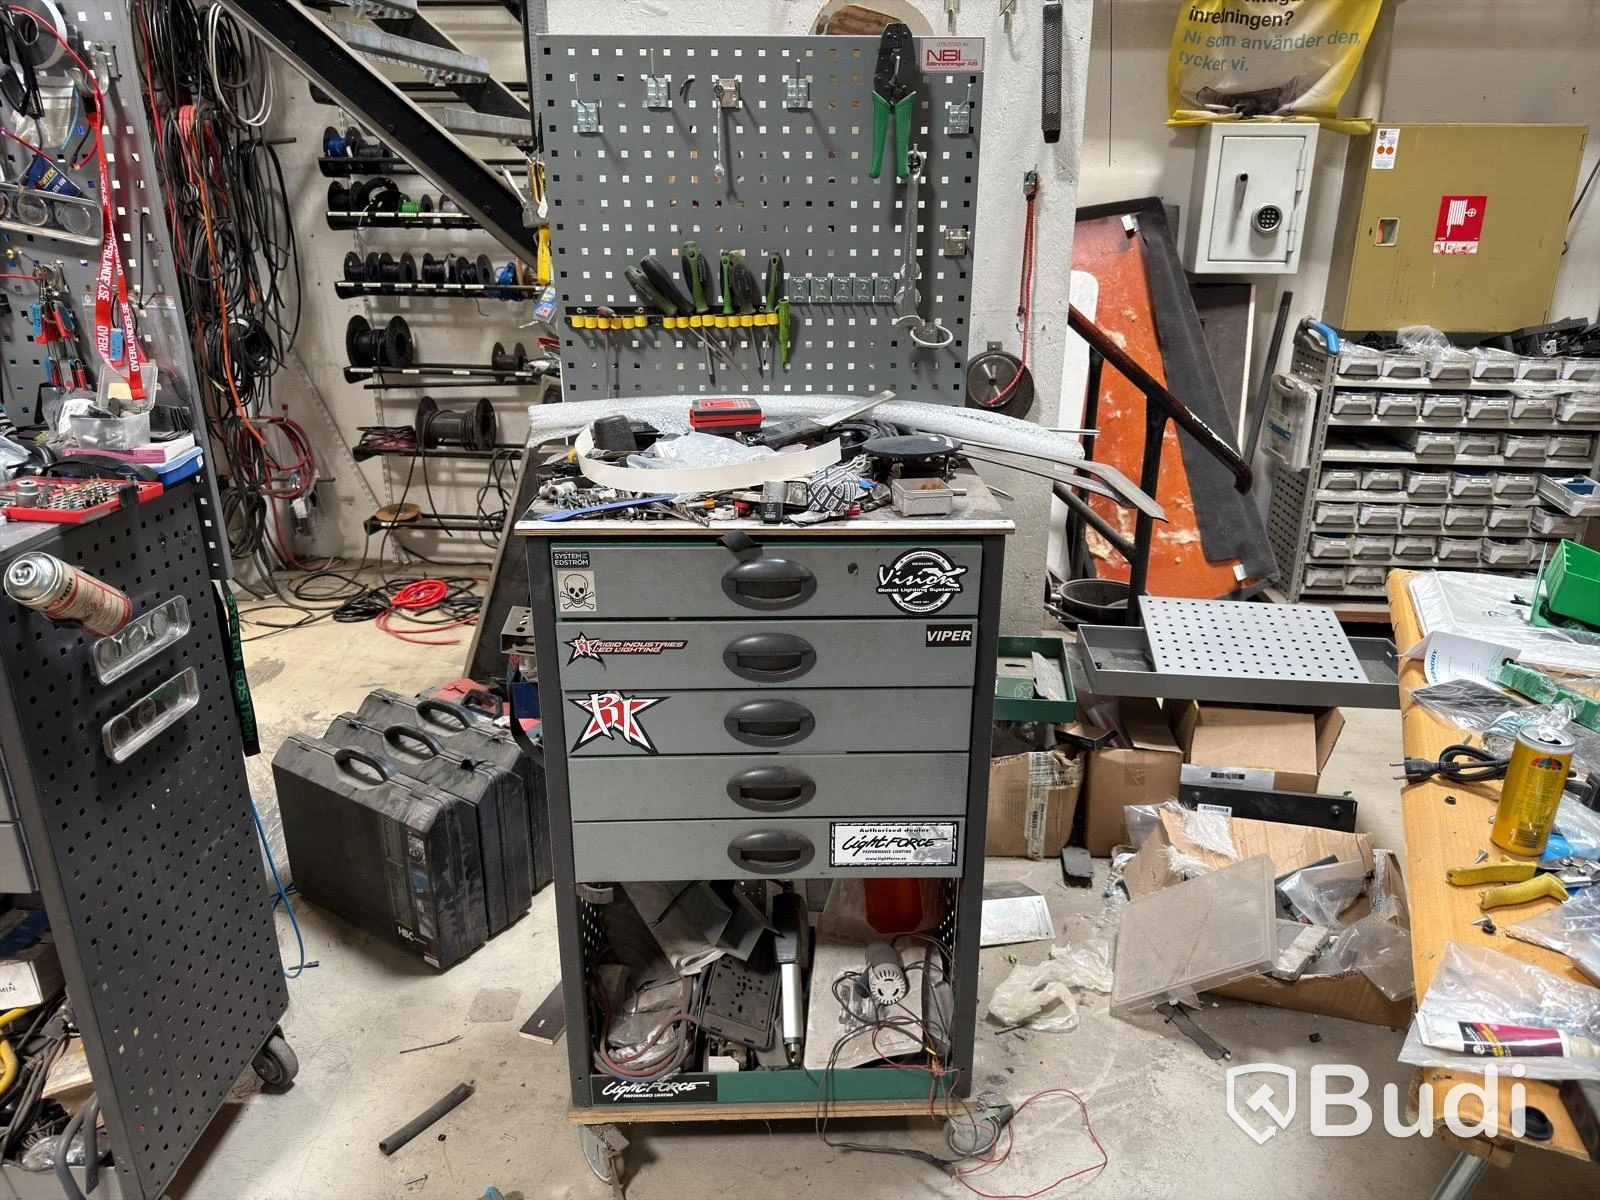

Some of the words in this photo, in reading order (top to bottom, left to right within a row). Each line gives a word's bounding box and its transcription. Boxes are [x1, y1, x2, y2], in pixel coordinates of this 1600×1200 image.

[1183, 29, 1201, 44] Ni
[1207, 34, 1236, 49] som
[1242, 33, 1324, 50] använder
[1327, 30, 1361, 46] den,
[927, 49, 961, 61] NBI
[1179, 50, 1227, 71] tycker
[1231, 56, 1248, 71] vi.
[97, 232, 114, 302] OVERLANDE.SE
[121, 302, 139, 372] OVERLANDER.SE
[226, 594, 242, 661] SYSTEM
[927, 630, 972, 642] VIPER
[623, 641, 684, 649] INDUSTRIES
